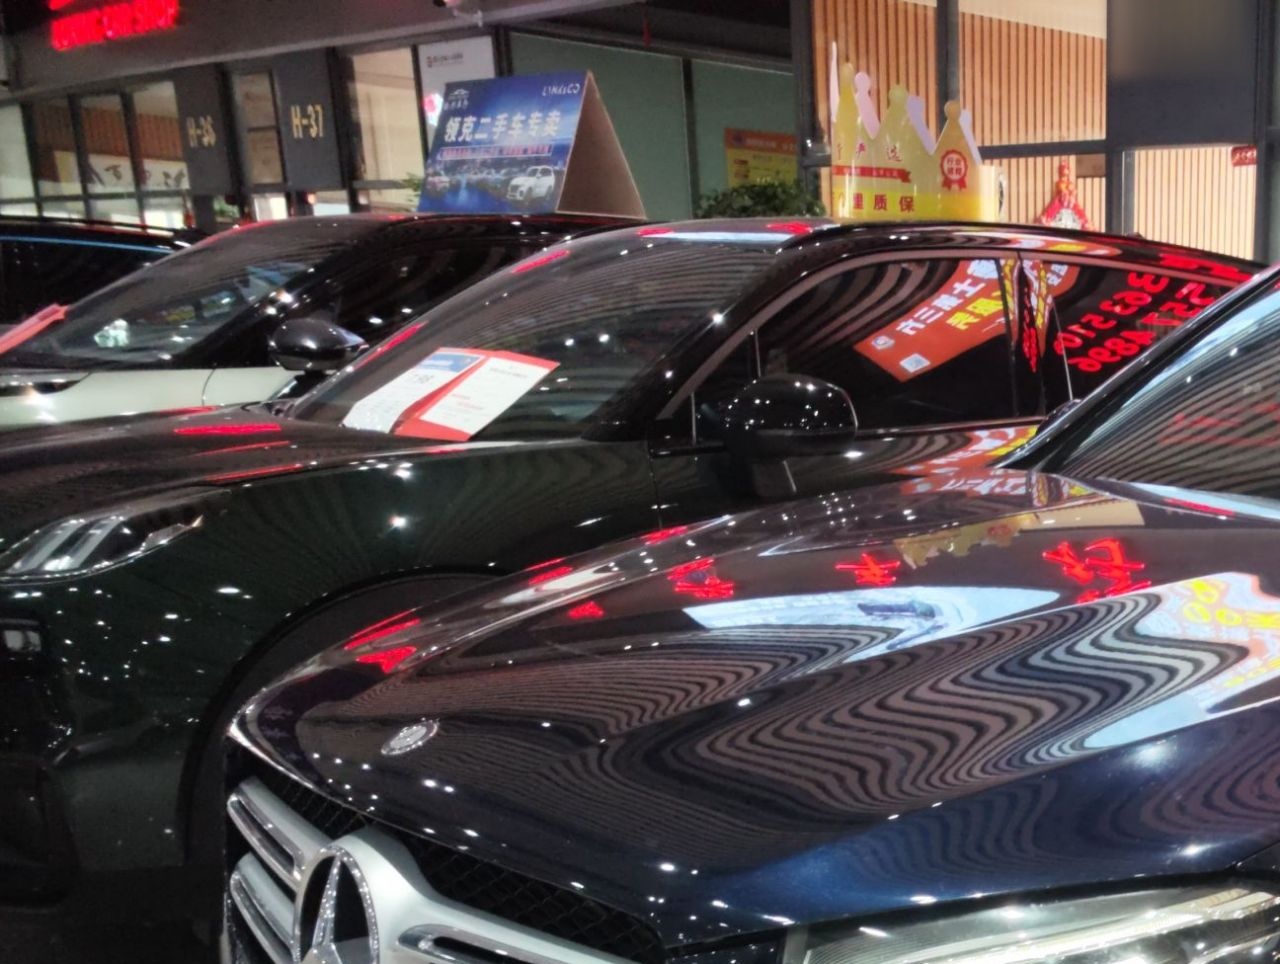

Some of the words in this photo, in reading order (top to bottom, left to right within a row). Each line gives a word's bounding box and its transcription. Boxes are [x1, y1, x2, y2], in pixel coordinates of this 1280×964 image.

[291, 104, 323, 139] H-37
[444, 110, 561, 142] 领克二手车专卖
